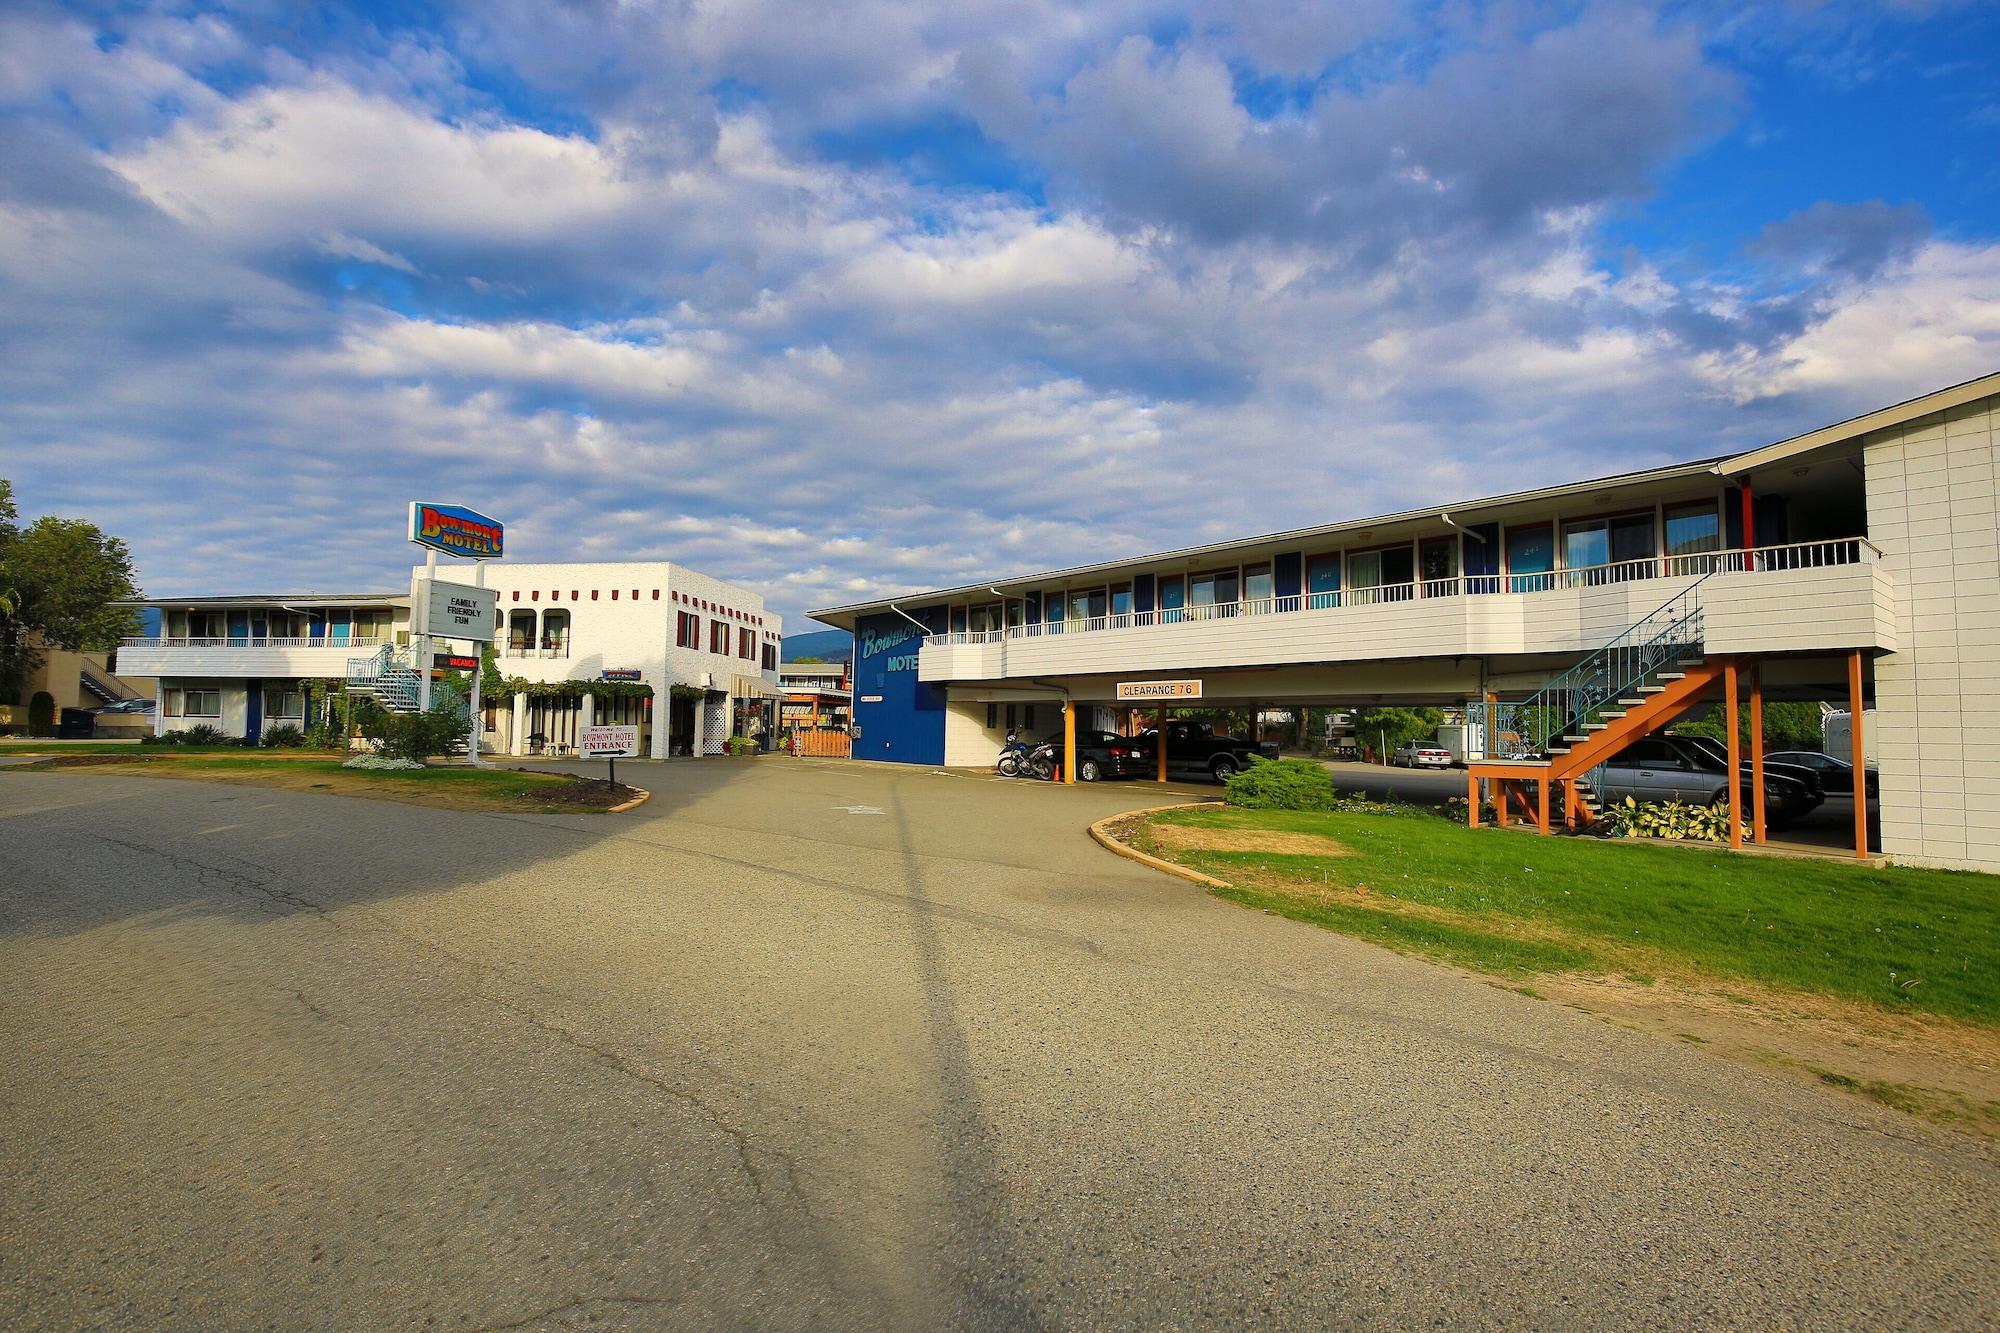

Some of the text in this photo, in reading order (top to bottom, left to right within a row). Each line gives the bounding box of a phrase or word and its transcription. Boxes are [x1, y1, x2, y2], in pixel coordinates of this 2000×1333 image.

[421, 507, 502, 551] Bowmont
[442, 531, 490, 553] MOTEL
[450, 597, 478, 607] FAMILY
[447, 605, 482, 618] FRIENDLY
[454, 616, 469, 625] FUN
[449, 657, 477, 668] VACANCY
[1124, 685, 1176, 695] CLEARANCE
[582, 732, 635, 742] BOWMONT MOTEL
[584, 741, 633, 750] ENTRANCE
